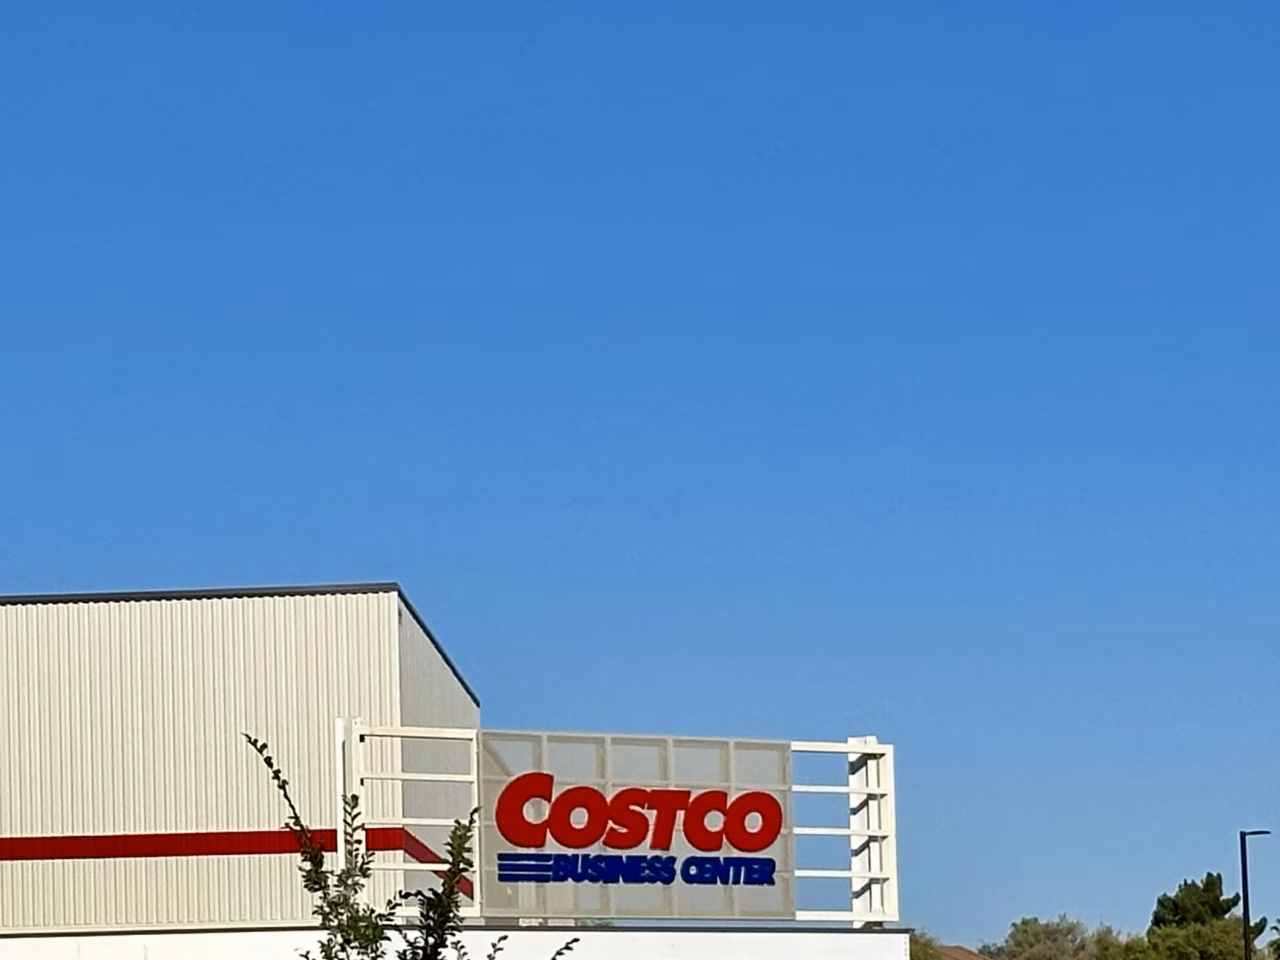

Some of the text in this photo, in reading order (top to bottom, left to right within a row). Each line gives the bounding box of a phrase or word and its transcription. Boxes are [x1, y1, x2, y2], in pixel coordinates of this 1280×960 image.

[496, 772, 783, 853] COSTCO
[552, 854, 776, 886] BUSINESS CENTER
